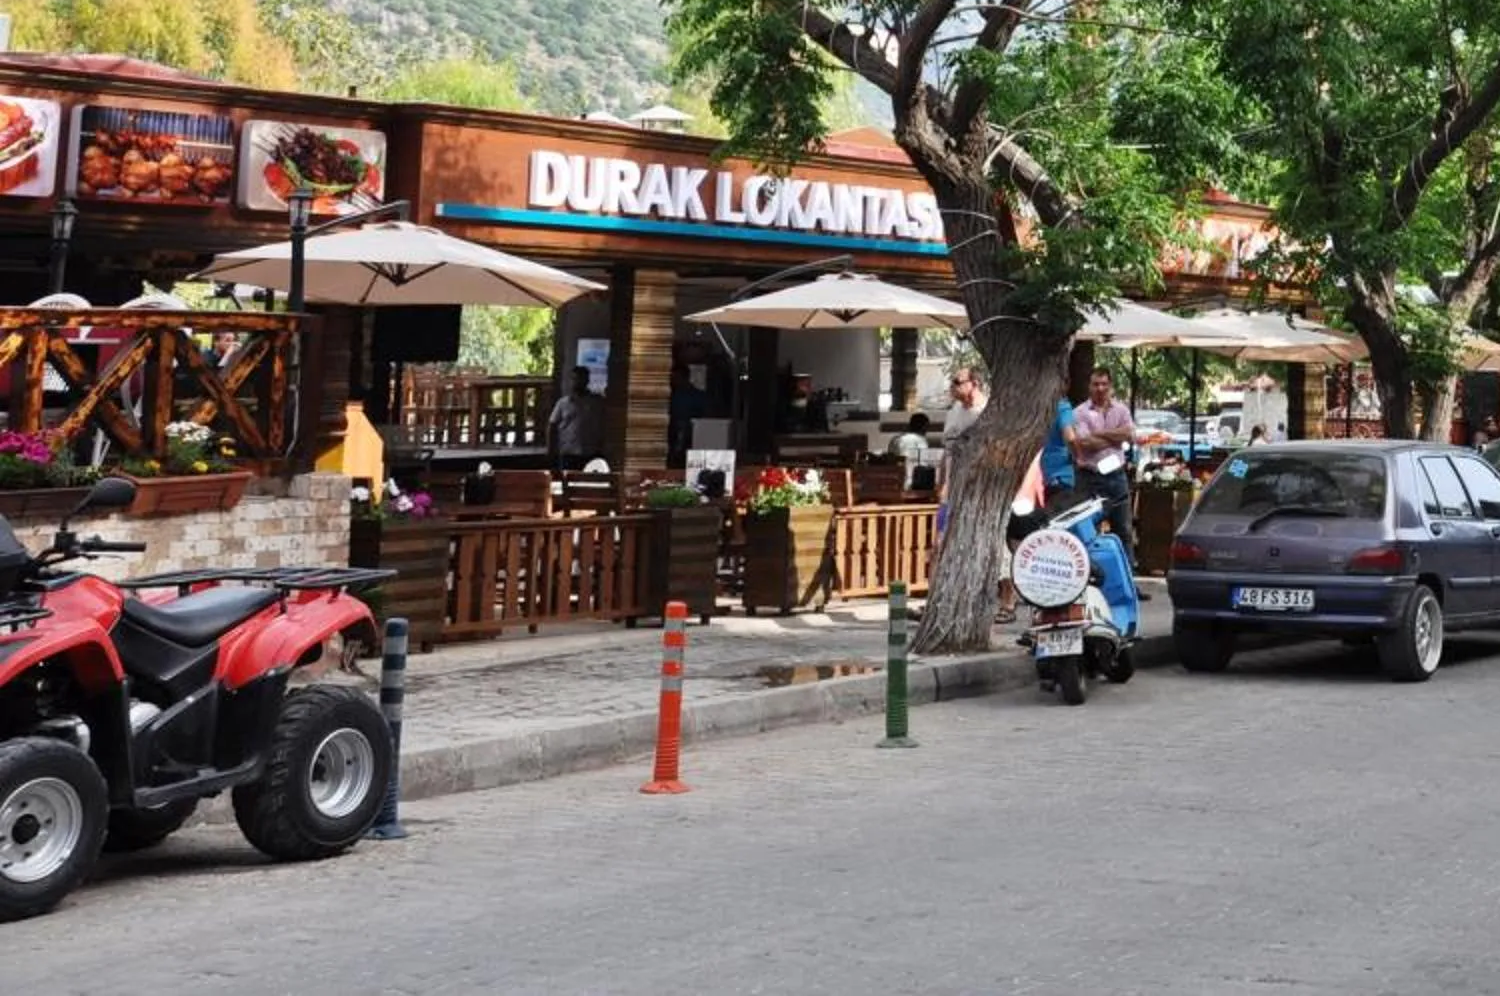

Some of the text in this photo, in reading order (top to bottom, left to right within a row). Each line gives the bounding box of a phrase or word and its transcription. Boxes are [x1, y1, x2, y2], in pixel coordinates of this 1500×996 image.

[528, 148, 945, 240] DURAK LOKANTASI
[1241, 587, 1311, 606] 48 FS 316
